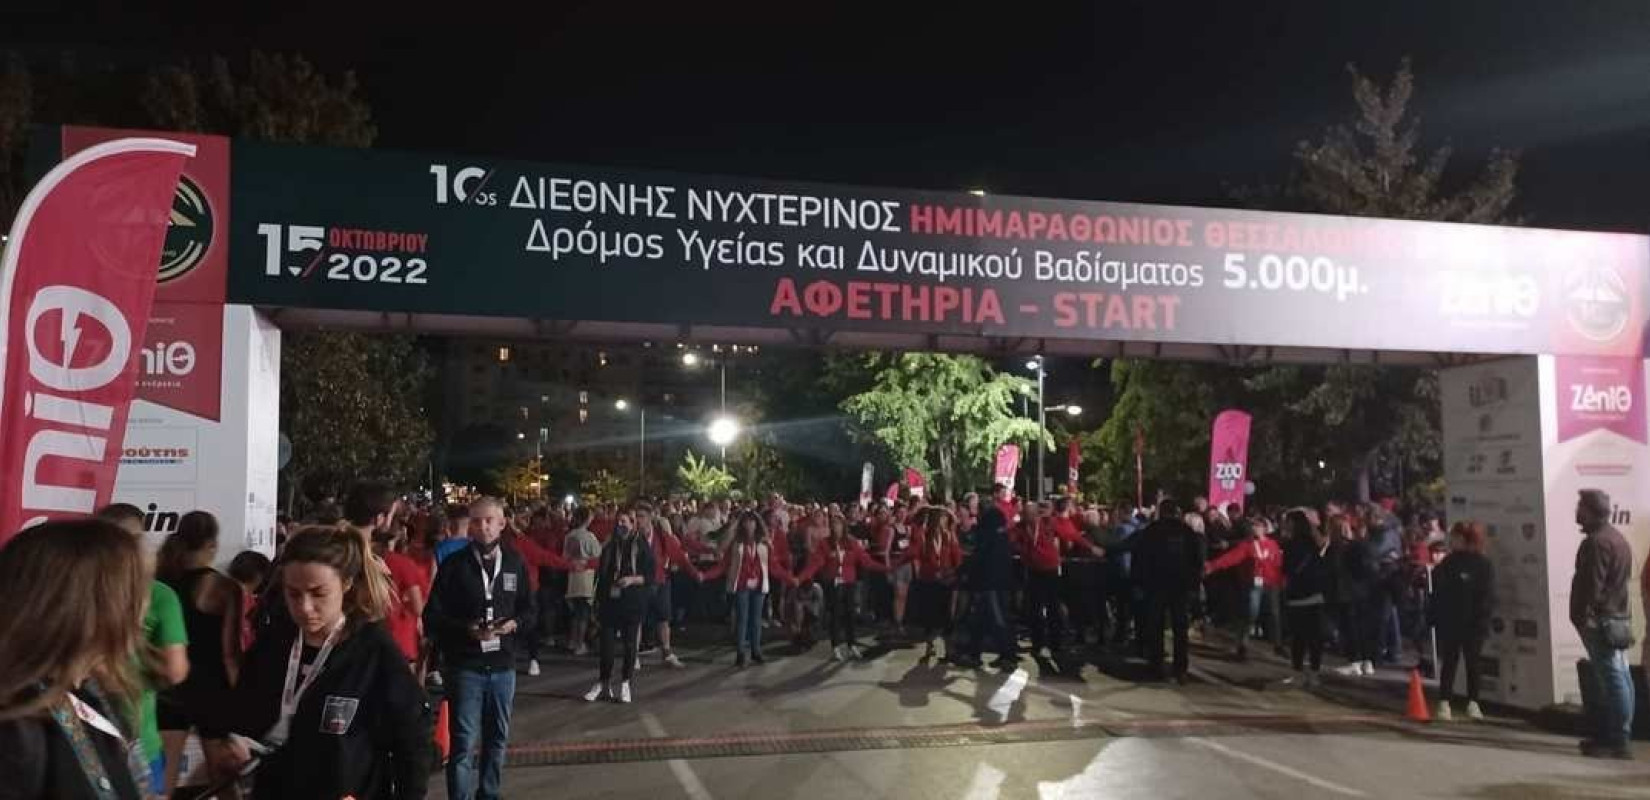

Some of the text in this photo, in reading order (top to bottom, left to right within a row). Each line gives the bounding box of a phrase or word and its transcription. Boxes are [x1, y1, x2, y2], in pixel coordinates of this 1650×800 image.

[509, 175, 677, 219] ΔΙΕΘΝΗΣ
[687, 188, 901, 232] ΝΥΧΤΕΡΙΝΟΣ
[909, 204, 1194, 248] ΗΜΙΜΑΡΑΘΩΝΙΟΣ
[257, 222, 325, 277] 15
[329, 227, 428, 253] ΟΚΤΩΒΡΙΟΥ
[525, 217, 1369, 301] Δρόμος Υγείας και Δυναμικού Βαδίσματος 5.000μ.
[327, 253, 428, 284] 2022
[769, 277, 1006, 325] ΑΦΕΤΗΡΙΑ
[1054, 292, 1181, 330] START
